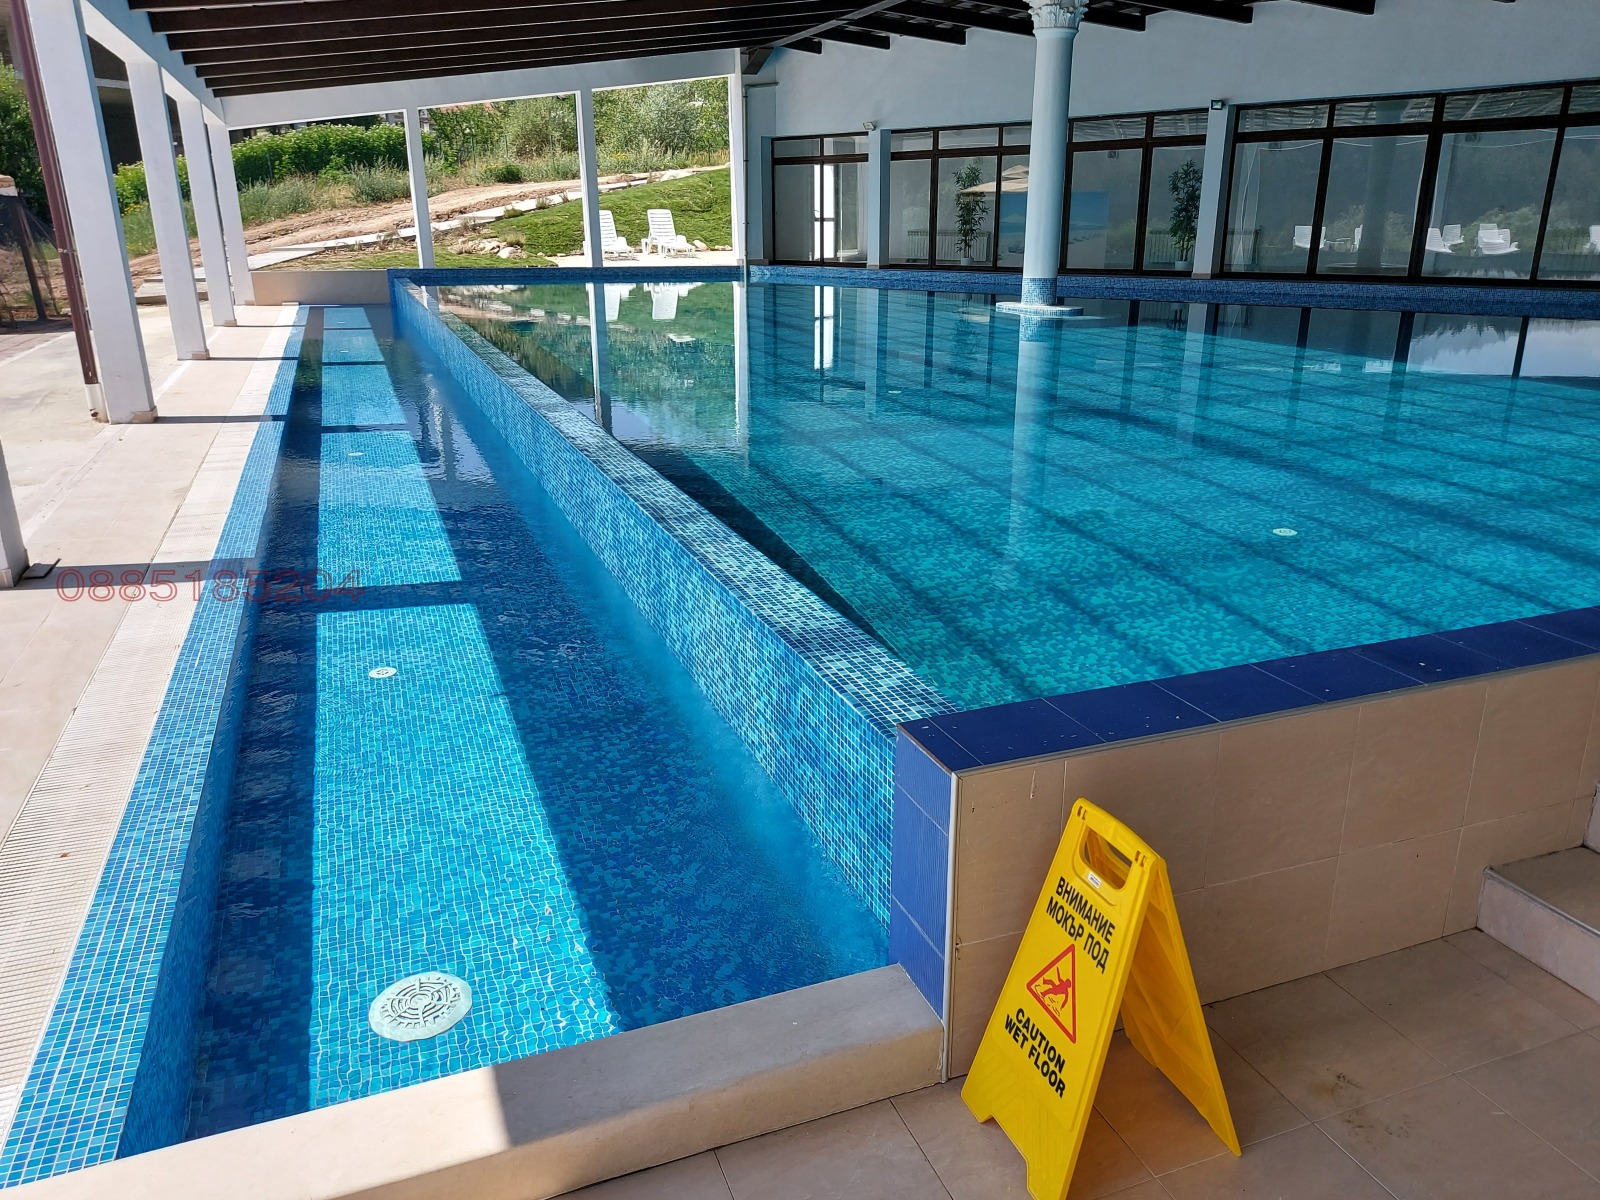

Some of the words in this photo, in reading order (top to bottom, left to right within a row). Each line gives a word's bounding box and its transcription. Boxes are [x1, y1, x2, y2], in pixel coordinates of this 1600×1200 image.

[1046, 896, 1085, 942] МОКЪР
[1083, 933, 1110, 974] ПОД
[1055, 876, 1116, 944] ВНИМАНИЕ
[1004, 1014, 1029, 1049] WET
[1028, 1044, 1066, 1098] FLOOR
[1015, 1008, 1066, 1073] CAUTION
